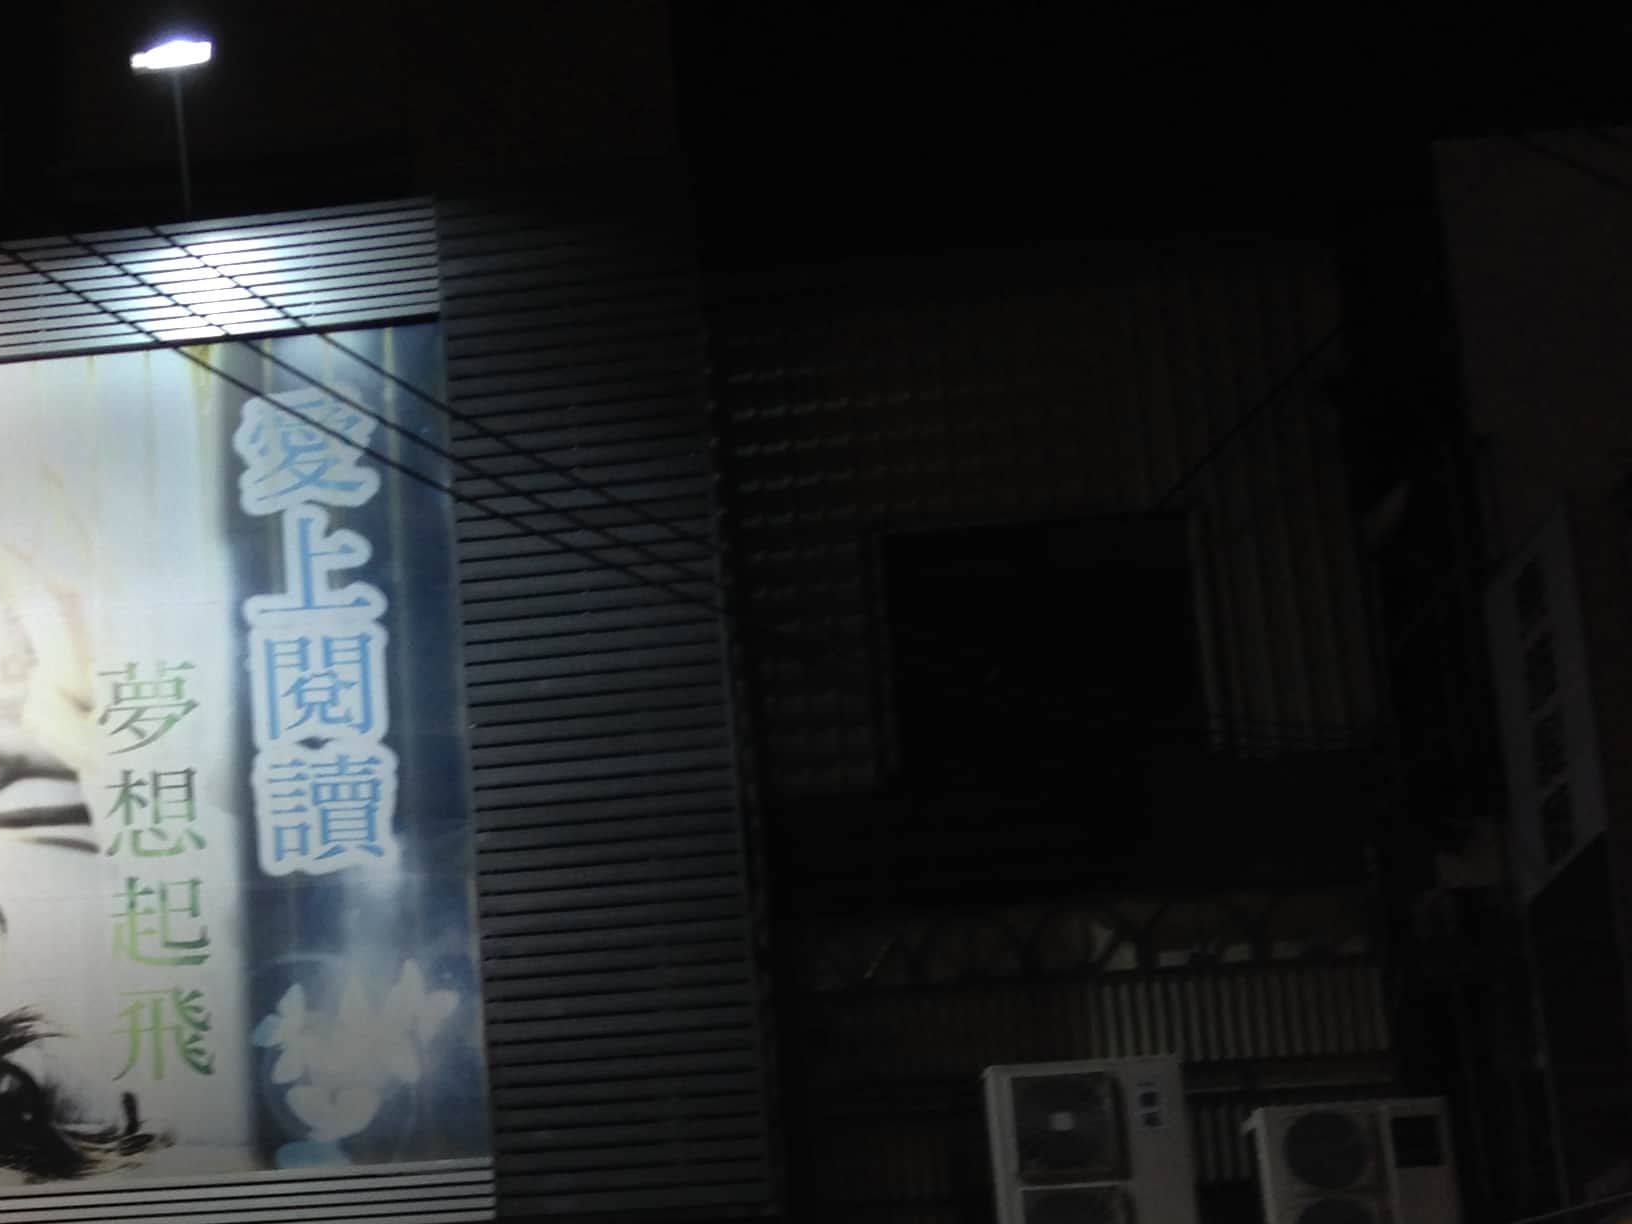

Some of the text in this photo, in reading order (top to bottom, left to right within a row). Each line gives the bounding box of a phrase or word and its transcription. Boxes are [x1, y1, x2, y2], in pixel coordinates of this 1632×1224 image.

[240, 390, 394, 870] 愛上閱讀
[96, 660, 216, 1082] 夢想起飛
